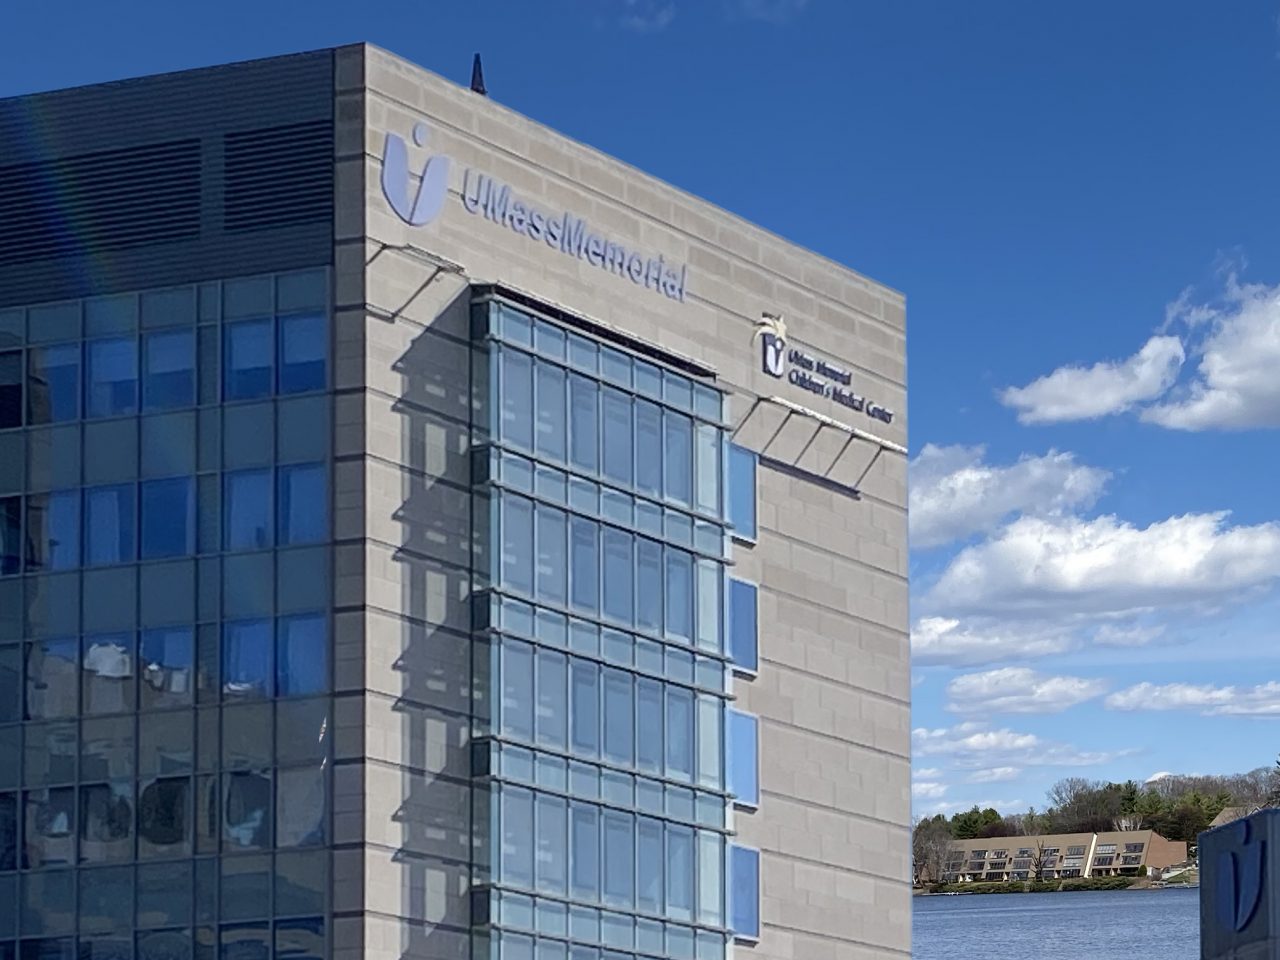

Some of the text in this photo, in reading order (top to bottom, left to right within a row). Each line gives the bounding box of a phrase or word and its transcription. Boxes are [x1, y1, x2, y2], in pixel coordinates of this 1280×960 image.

[816, 361, 852, 386] Memorial
[832, 386, 865, 413] Medical
[866, 401, 894, 424] Center
